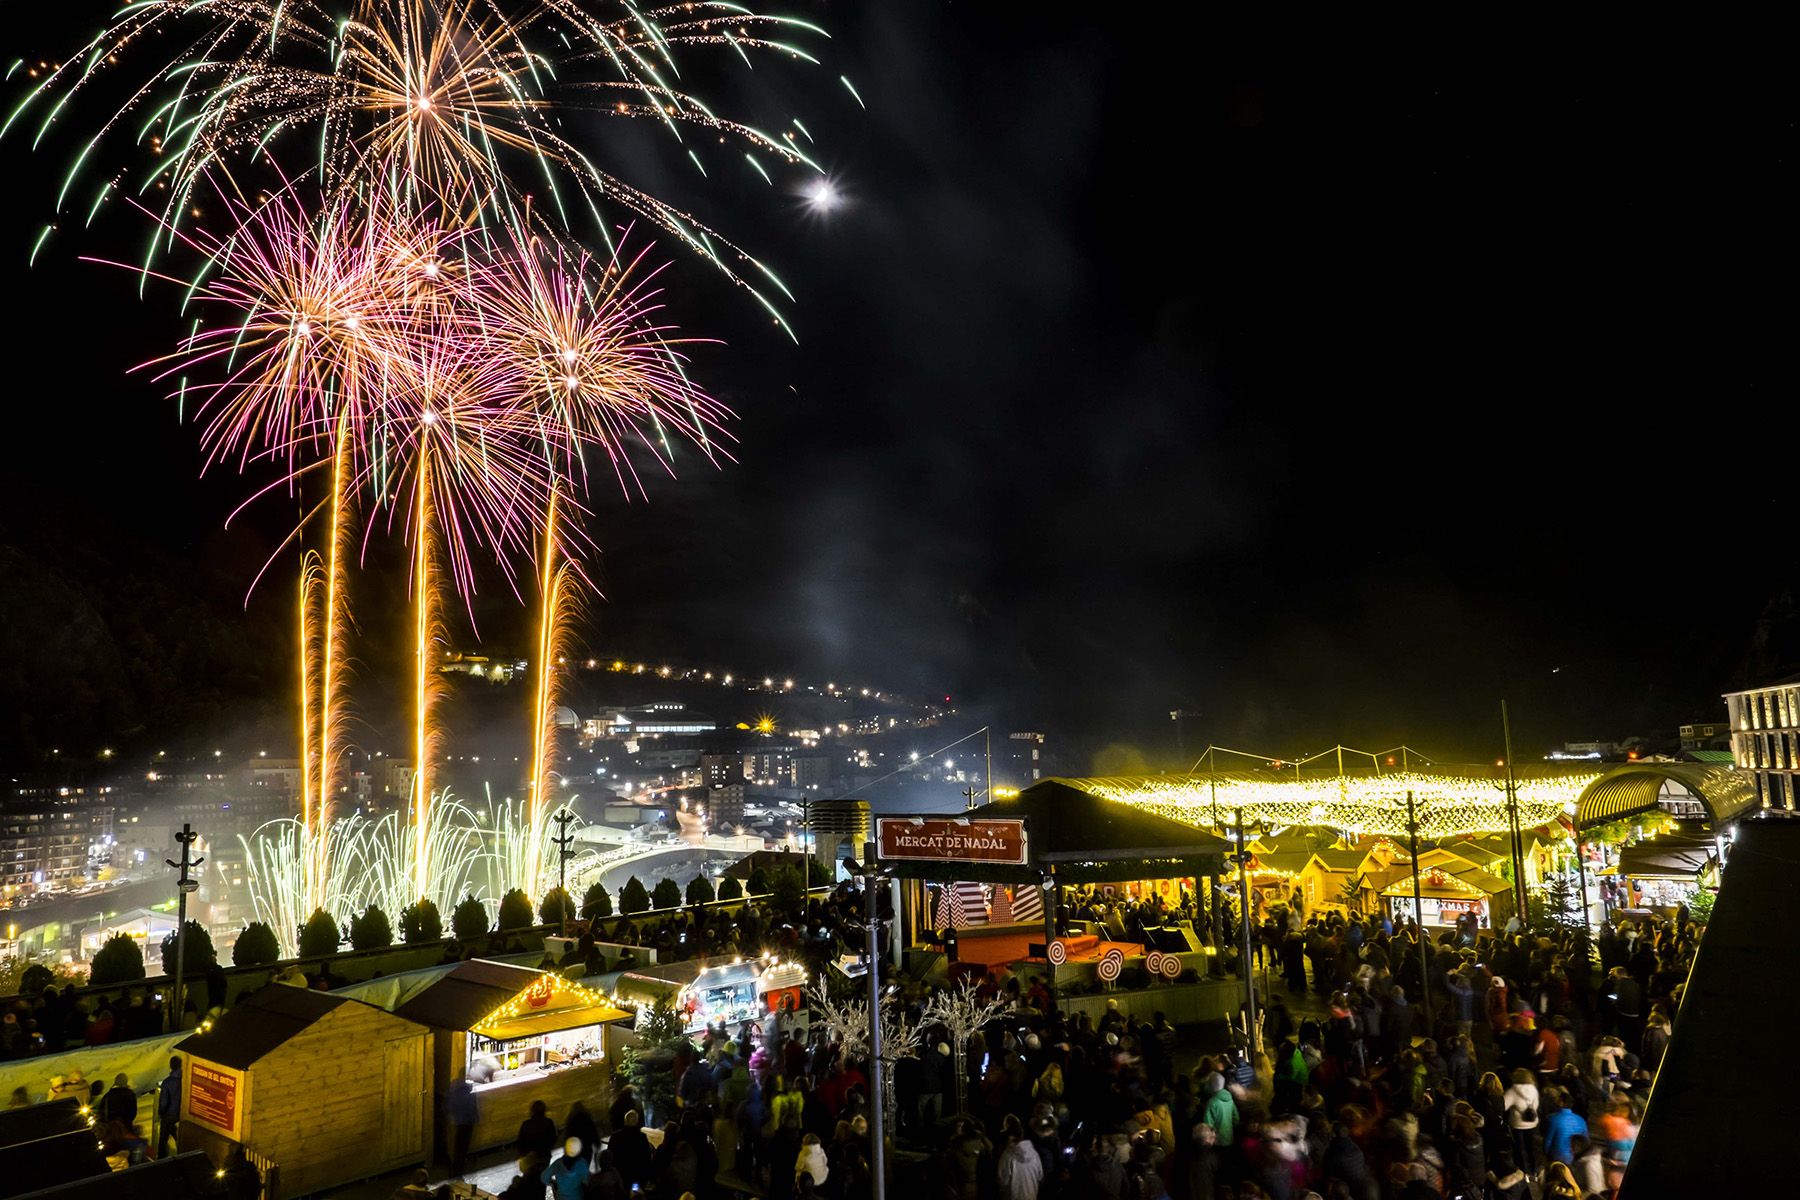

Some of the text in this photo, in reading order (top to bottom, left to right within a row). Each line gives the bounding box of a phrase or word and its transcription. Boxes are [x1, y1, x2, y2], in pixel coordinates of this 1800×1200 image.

[895, 836, 1007, 850] MERCAT DE NADAL
[1440, 902, 1470, 912] XMAS
